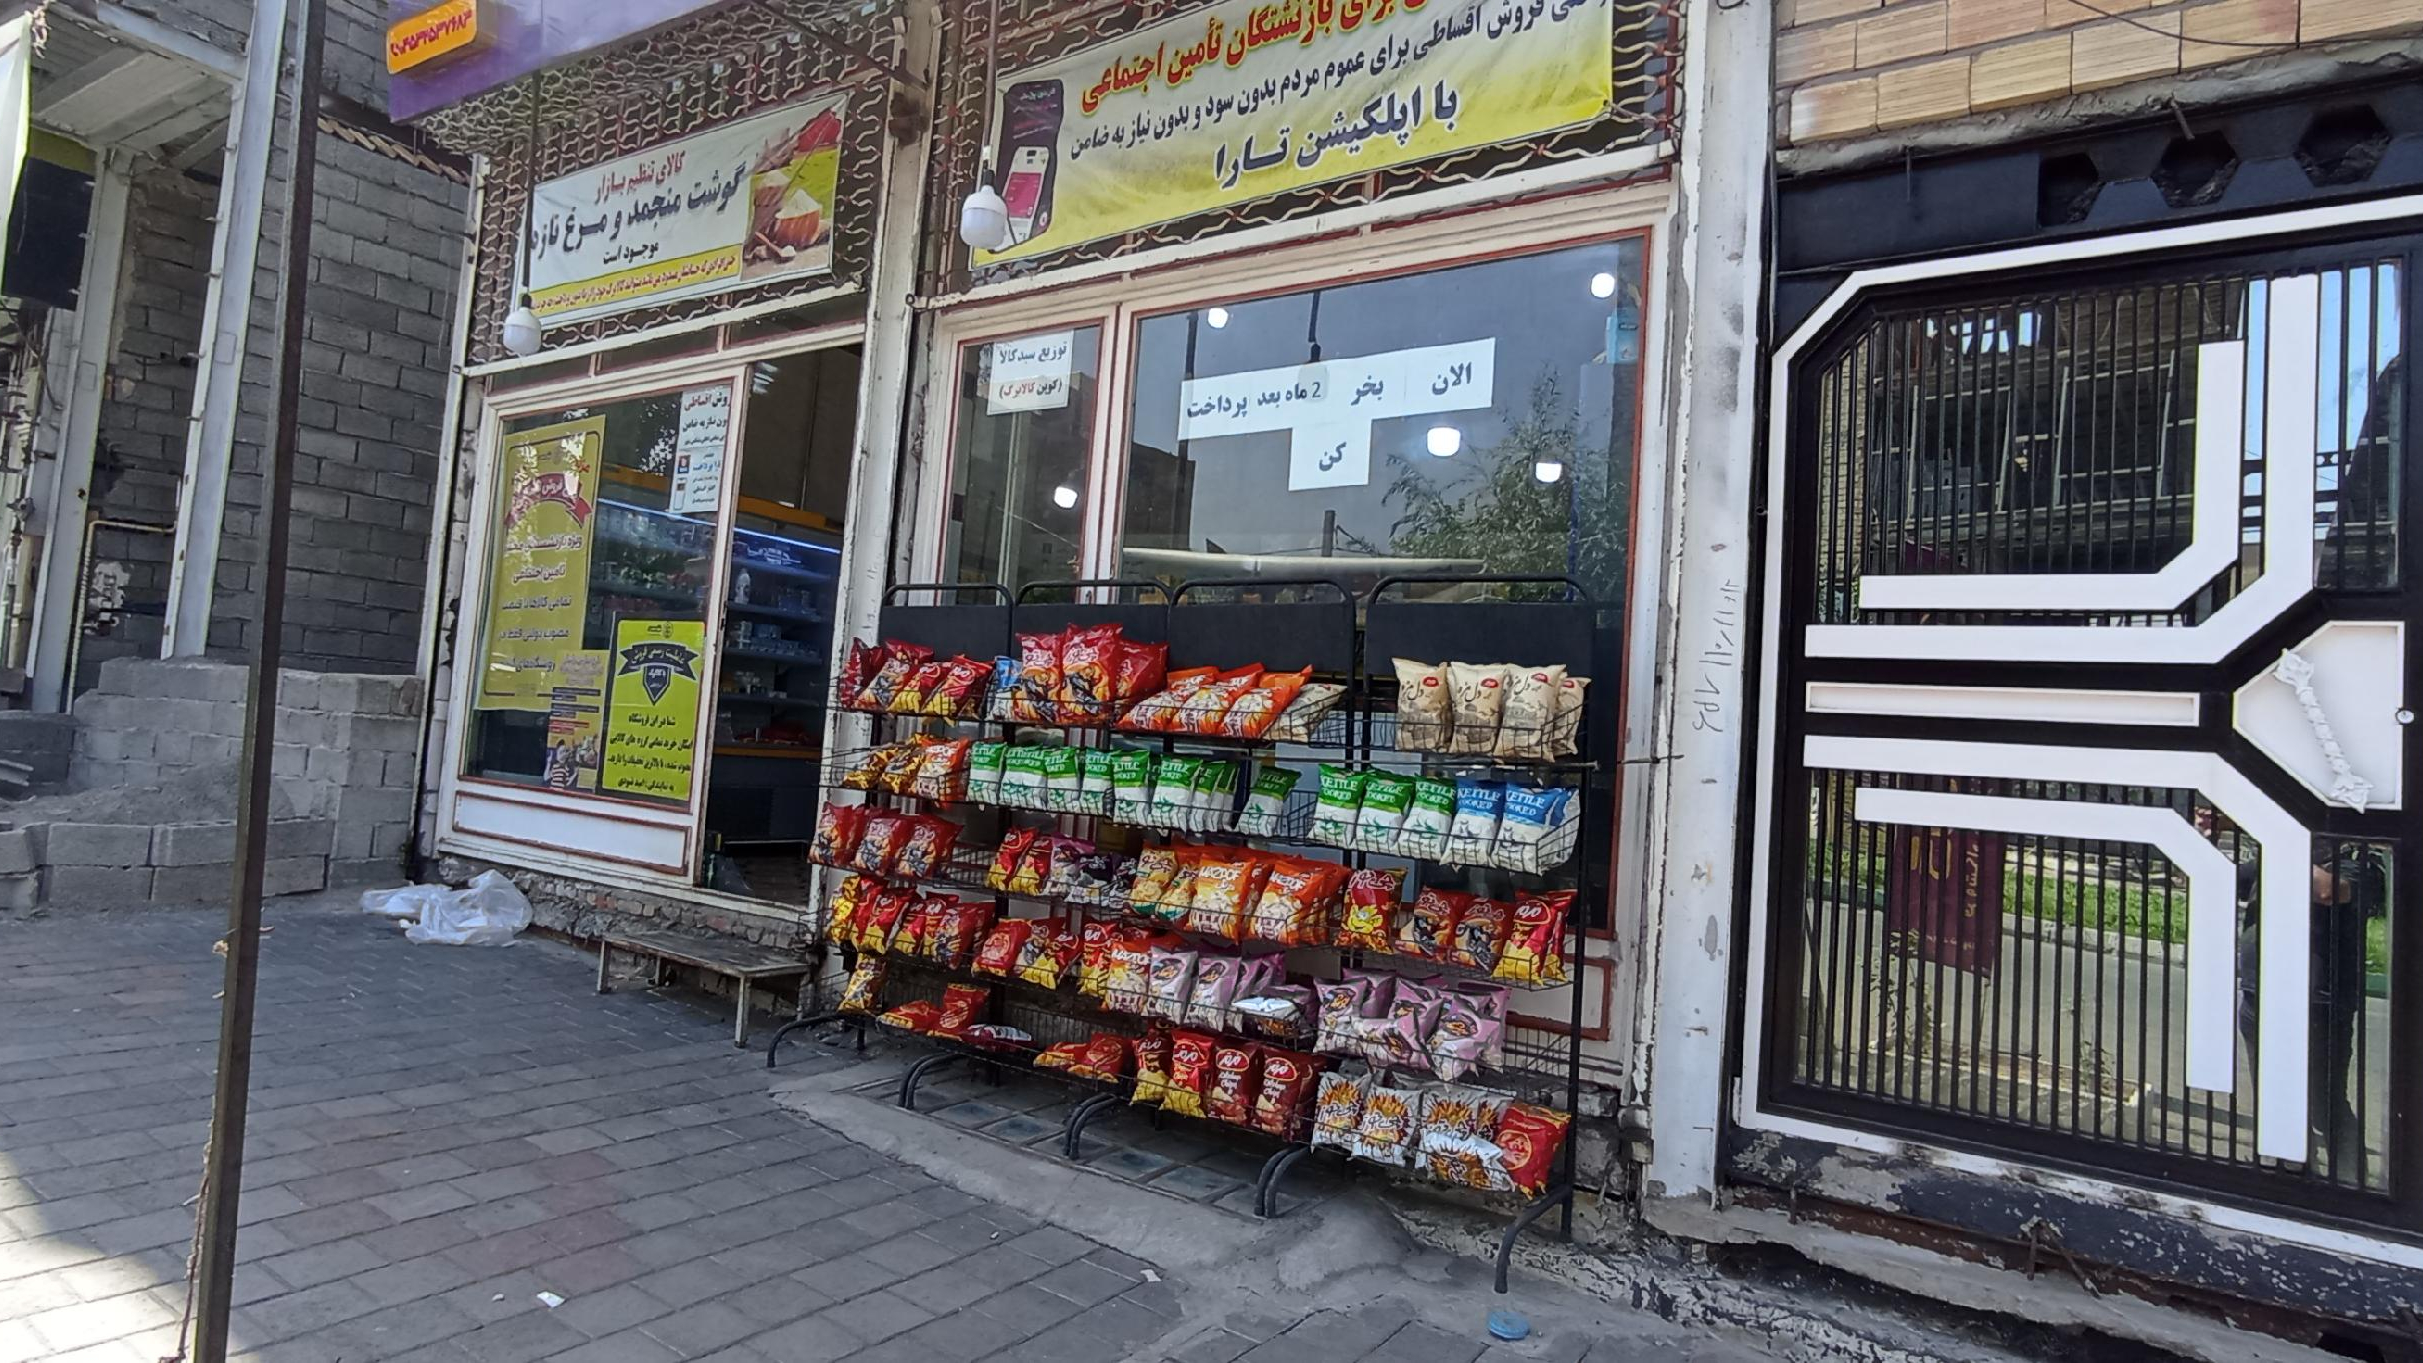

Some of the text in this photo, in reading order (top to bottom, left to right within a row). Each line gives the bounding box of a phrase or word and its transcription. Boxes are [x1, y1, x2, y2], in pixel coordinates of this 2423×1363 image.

[1165, 15, 1226, 86] تأمین
[1413, 3, 1482, 61] اقساطی
[1323, 48, 1365, 91] عموم
[1369, 33, 1411, 76] برای
[1081, 39, 1165, 115] اجتماعی
[1237, 77, 1277, 117] بدون
[1280, 65, 1321, 104] مردم
[1153, 105, 1190, 141] بدون
[1192, 104, 1201, 130] و
[1205, 92, 1235, 124] سود
[1433, 79, 1458, 131] با
[1070, 124, 1109, 161] ضامن
[1111, 124, 1125, 151] به
[1125, 109, 1151, 149] نیاز
[594, 151, 685, 205] کالای تنظیم بازار
[1212, 126, 1291, 191] تارا
[687, 160, 746, 212] گوشت
[563, 206, 608, 252] مرغ
[609, 210, 623, 241] و
[628, 188, 682, 230] منجمد
[603, 243, 659, 264] موجود است
[999, 341, 1068, 364] توزیع سبد کالا
[1186, 361, 1473, 418] الان بخر 2 ماه بعد پرداخت
[1318, 442, 1347, 472] کن
